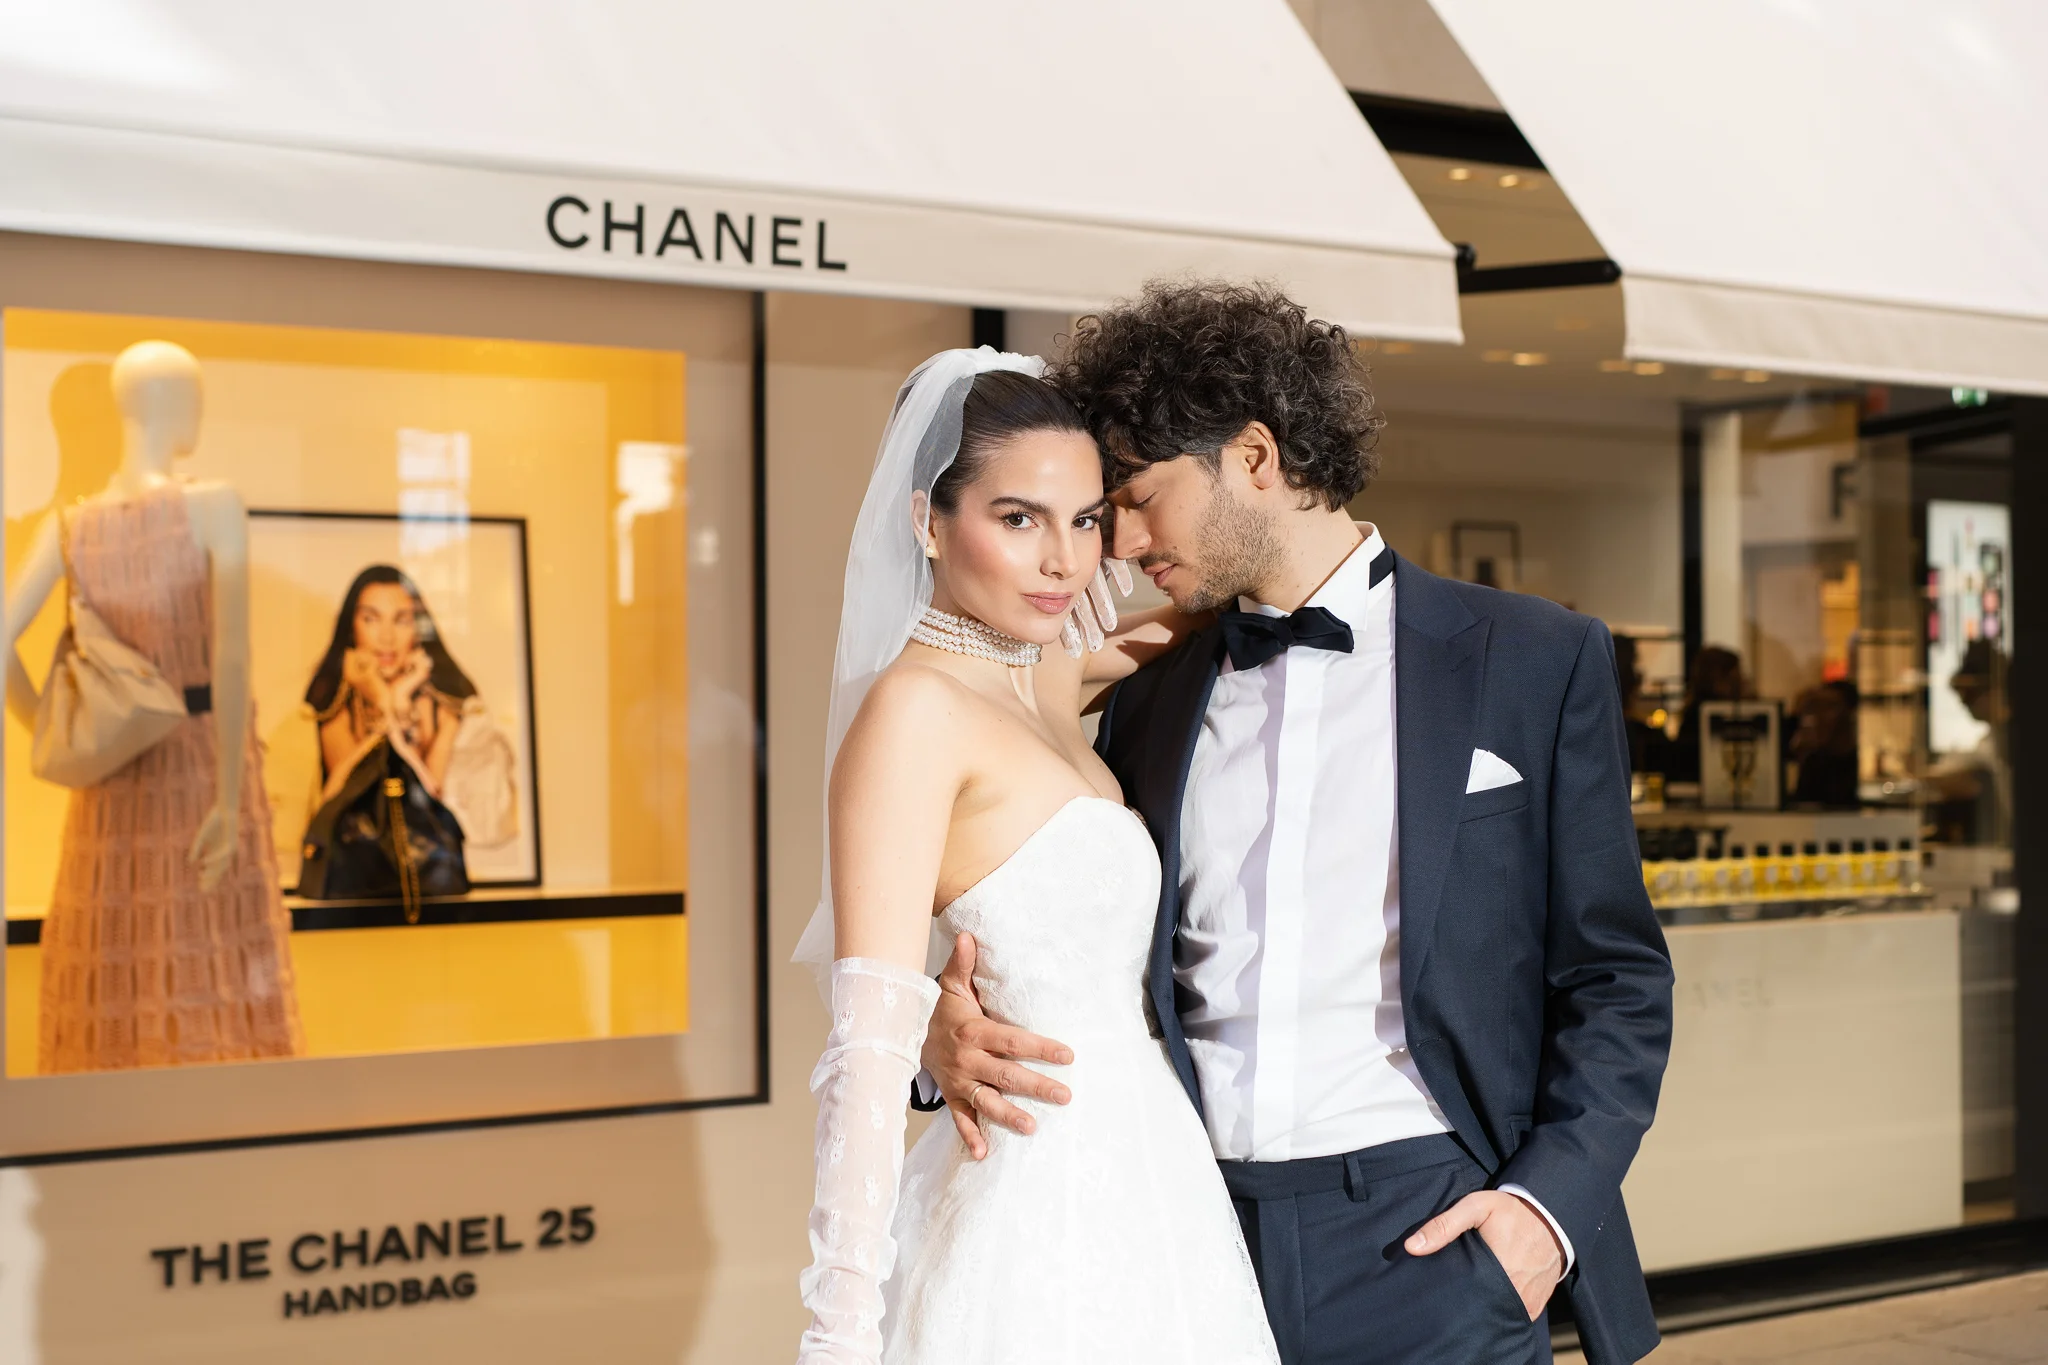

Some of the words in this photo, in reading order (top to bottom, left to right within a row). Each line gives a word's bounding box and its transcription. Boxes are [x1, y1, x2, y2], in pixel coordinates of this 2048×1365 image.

[546, 195, 848, 271] CHANEL
[150, 1237, 272, 1288] THE
[288, 1214, 524, 1274] CHANEL
[536, 1204, 597, 1250] 25
[282, 1271, 478, 1320] HANDBAG
